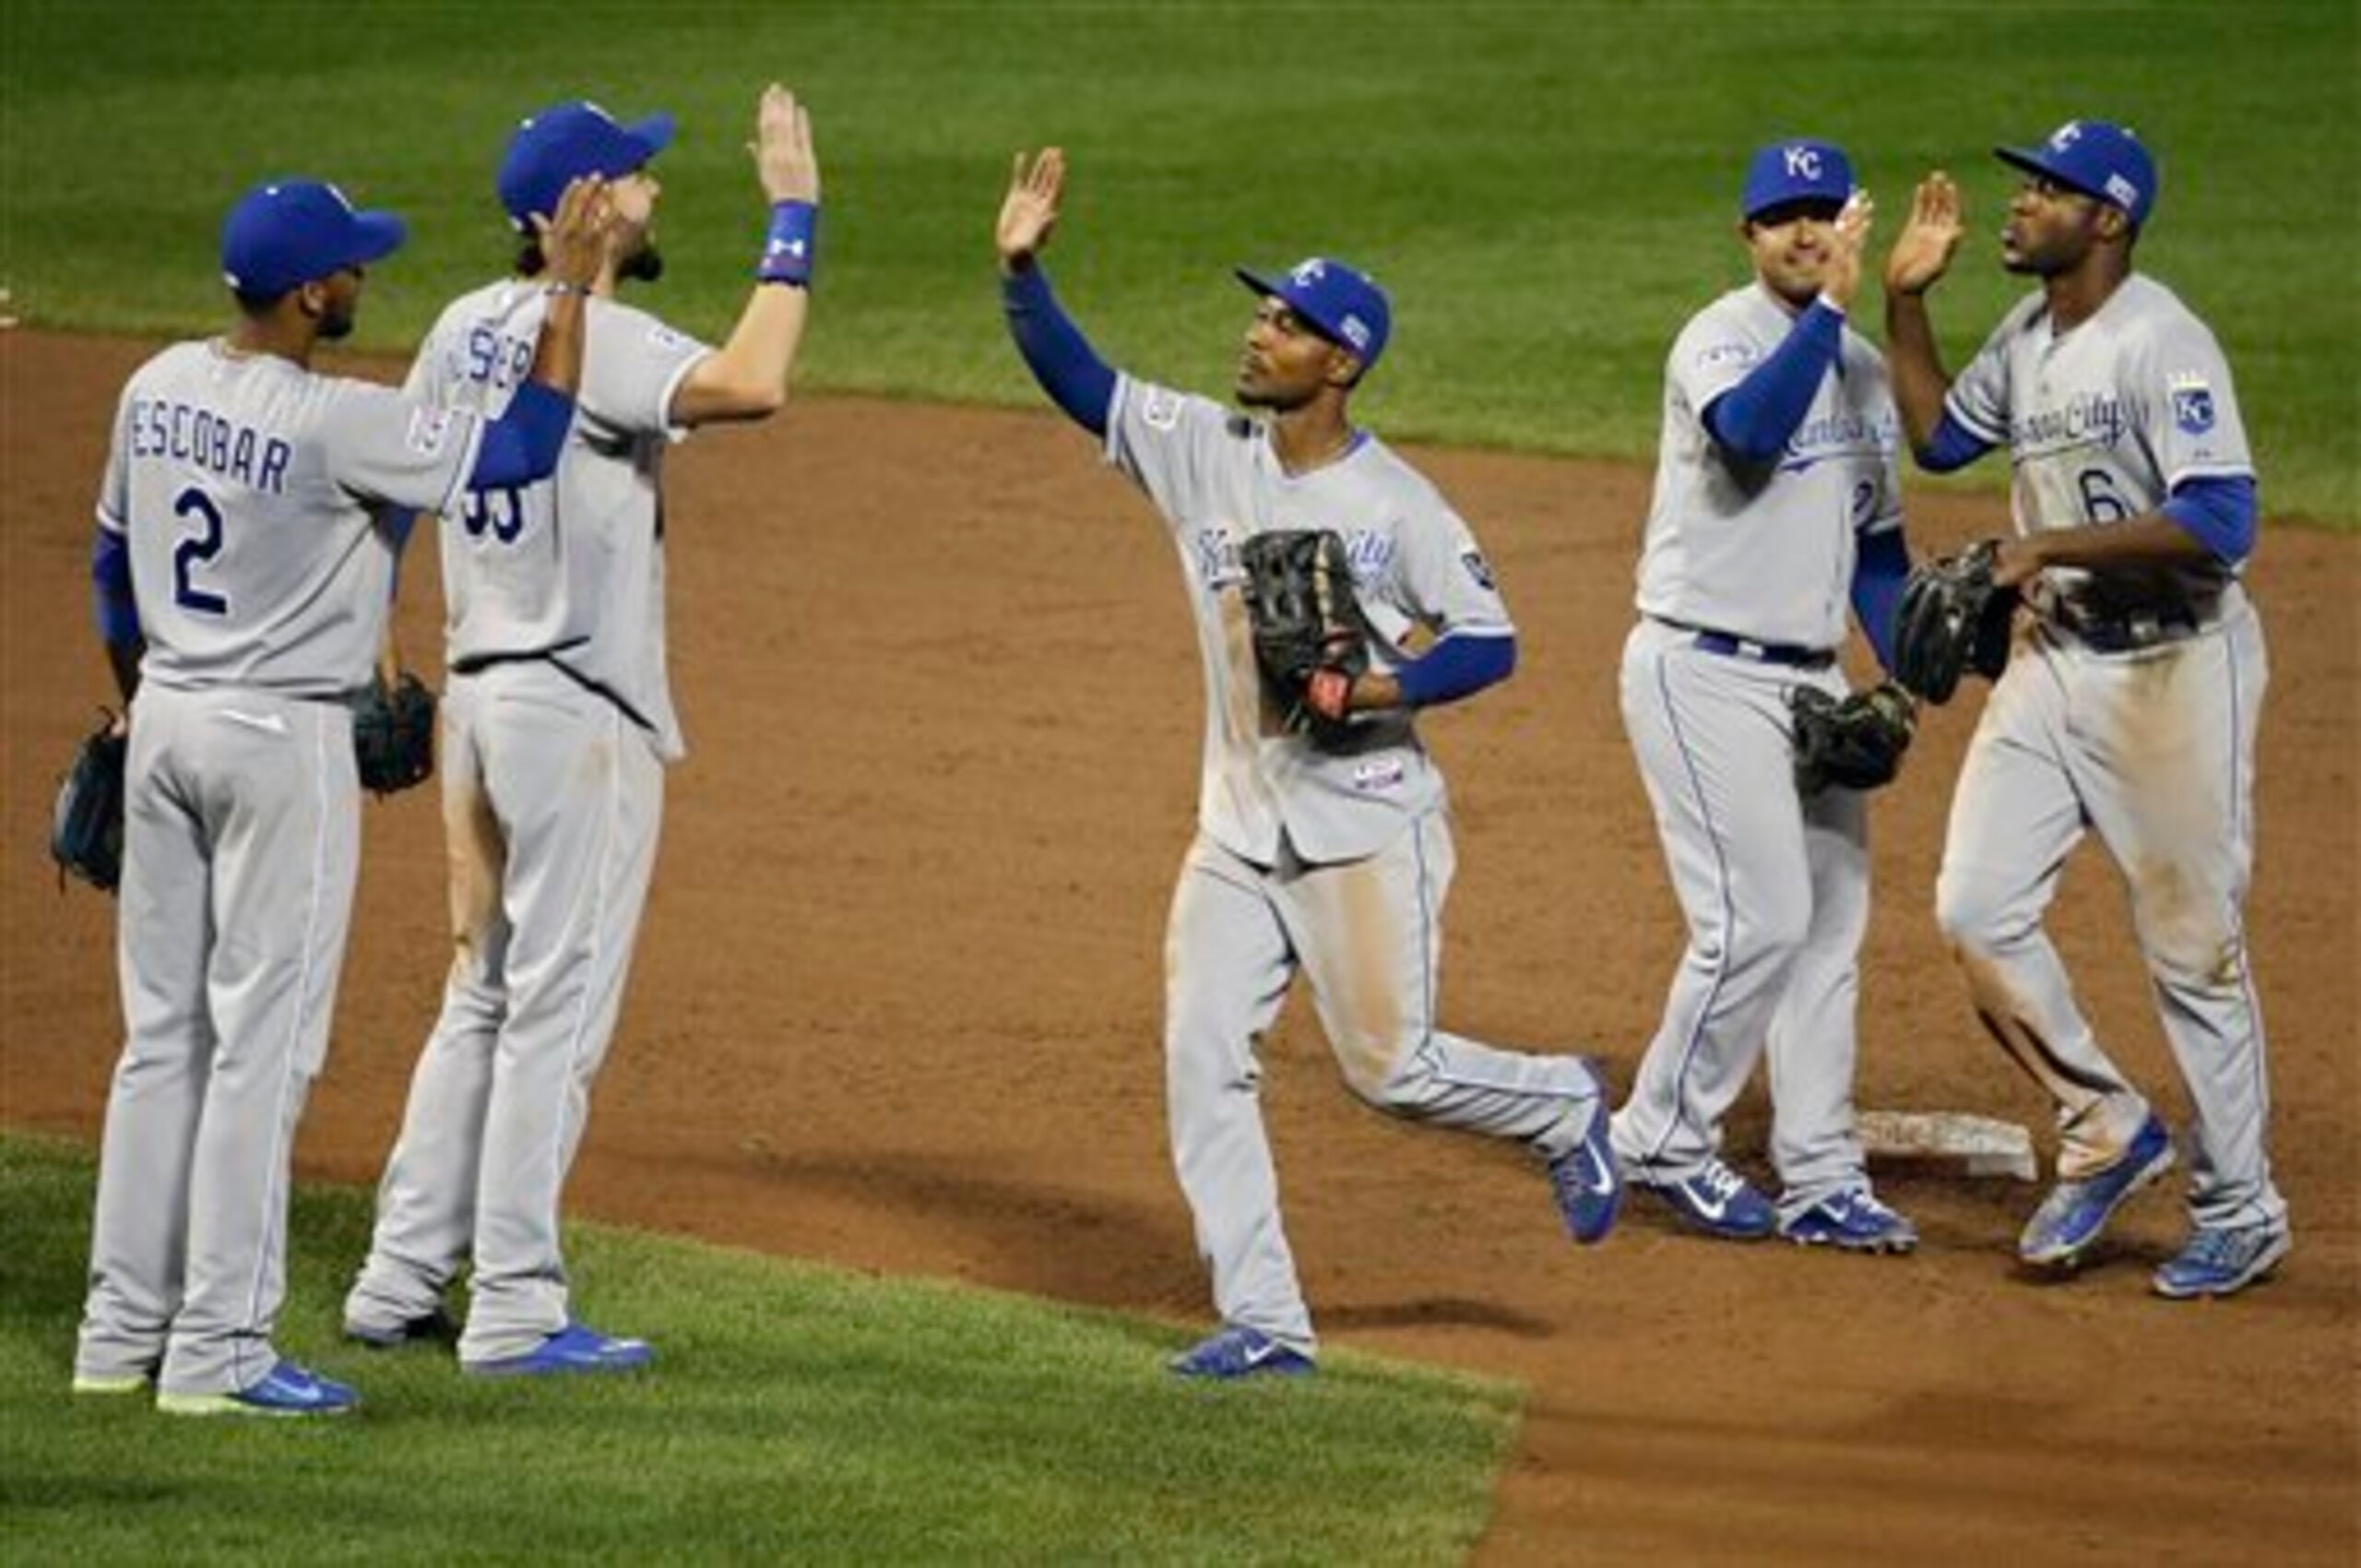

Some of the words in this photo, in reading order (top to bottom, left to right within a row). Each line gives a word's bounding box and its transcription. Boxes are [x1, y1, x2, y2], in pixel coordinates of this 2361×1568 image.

[1784, 146, 1821, 180] KC
[133, 399, 291, 495] ESCOBAR
[2079, 469, 2128, 524] 6
[174, 486, 228, 616] 2
